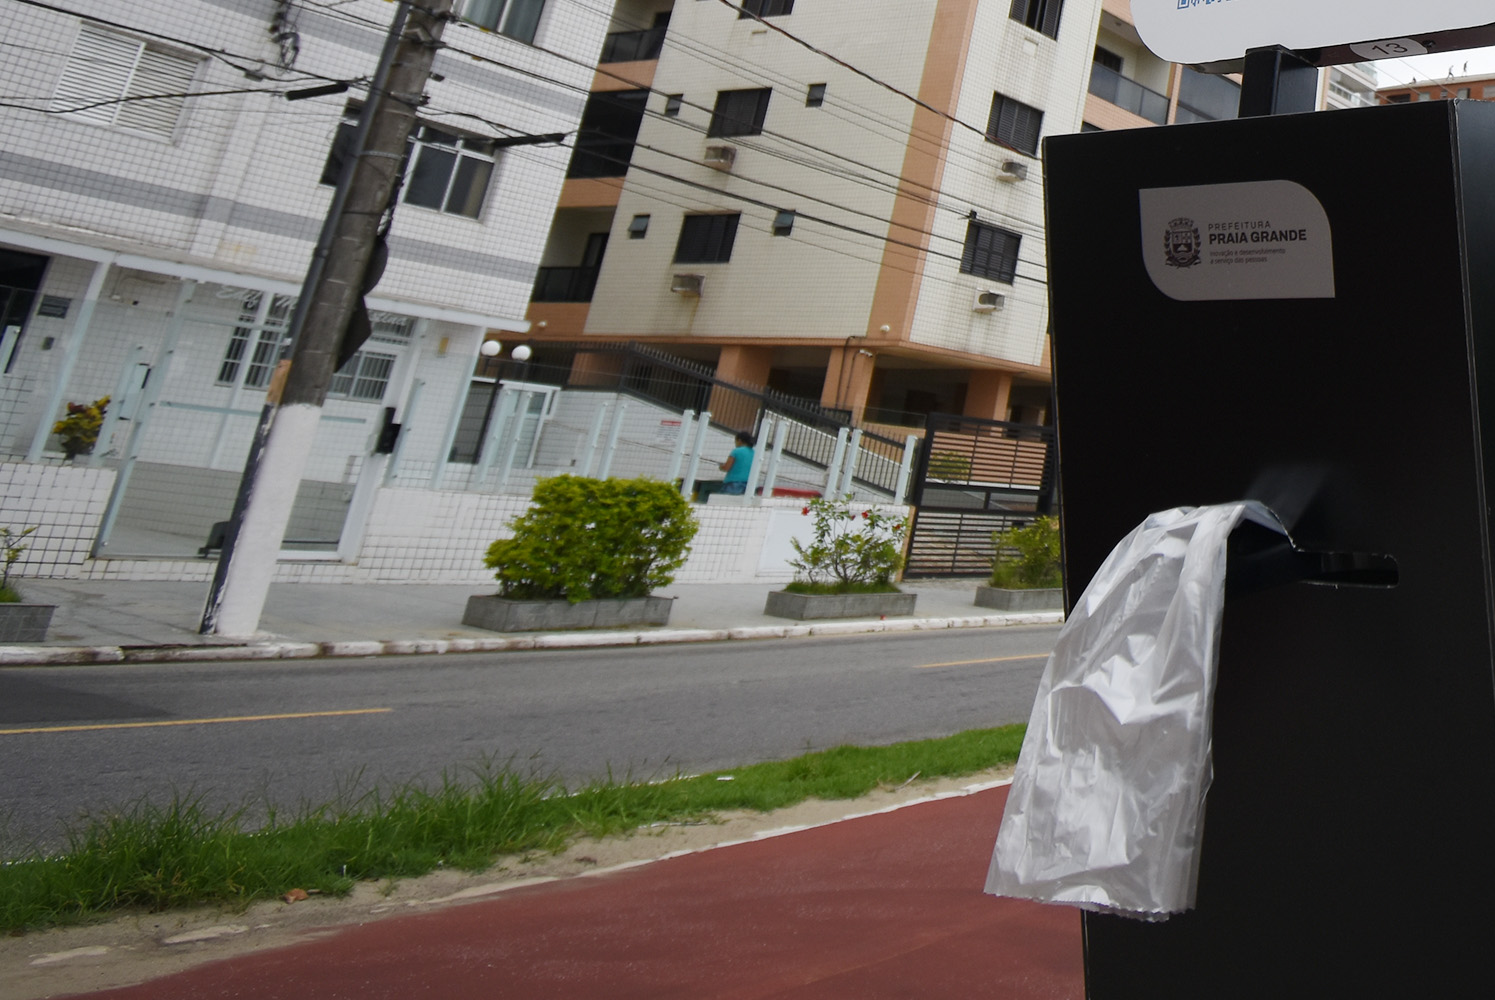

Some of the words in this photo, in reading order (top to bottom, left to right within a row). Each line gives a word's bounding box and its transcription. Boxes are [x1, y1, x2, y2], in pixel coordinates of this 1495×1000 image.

[1371, 42, 1408, 55] 13
[1208, 220, 1271, 231] PREFEITURA
[1209, 231, 1248, 245] PRAIA
[1250, 229, 1307, 243] GRANDE
